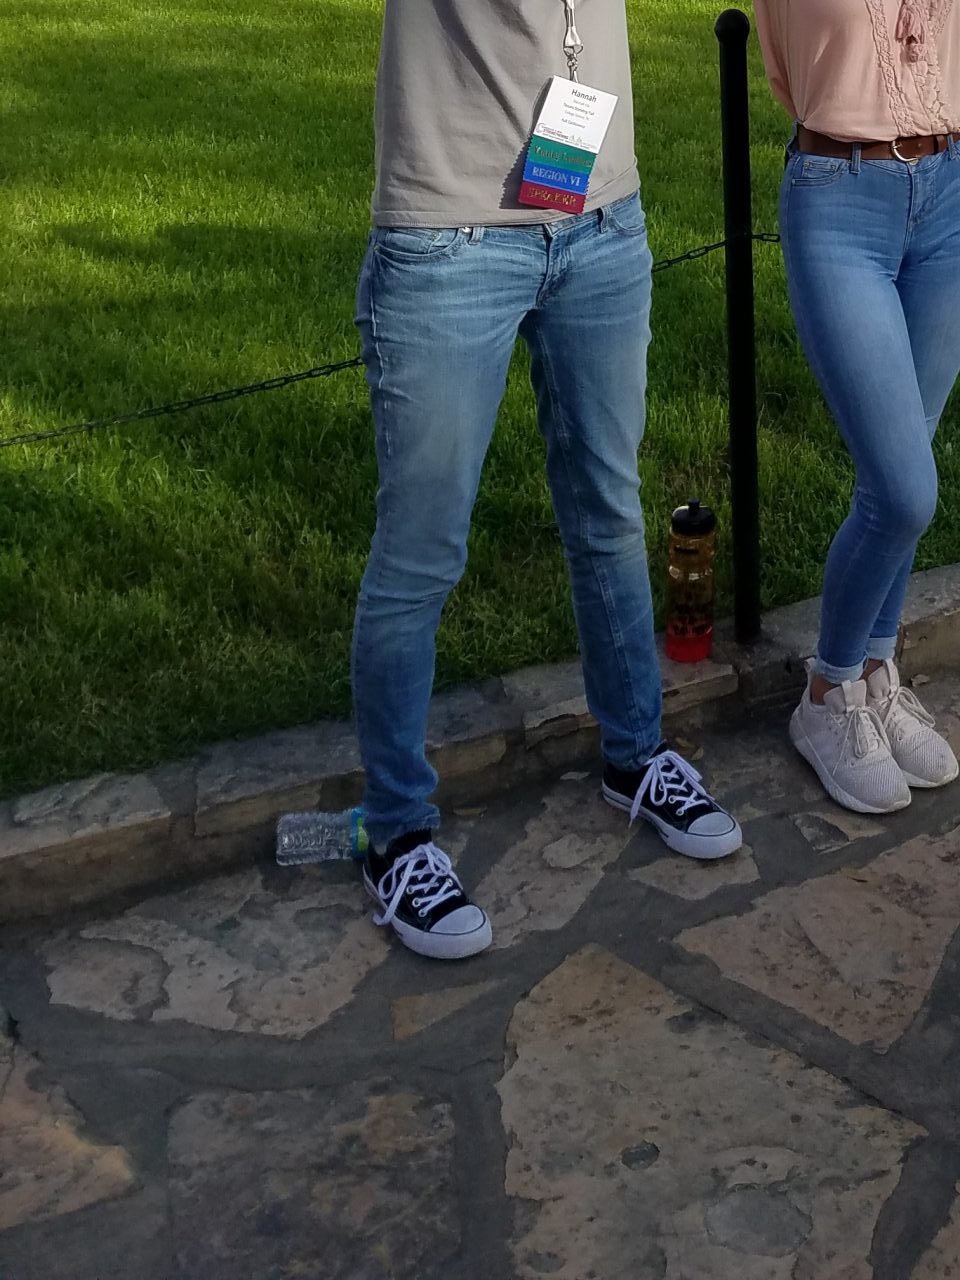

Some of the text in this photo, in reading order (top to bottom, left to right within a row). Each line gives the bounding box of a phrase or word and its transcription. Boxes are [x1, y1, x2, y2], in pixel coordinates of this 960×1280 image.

[571, 89, 597, 103] Hannah
[532, 166, 581, 187] REGION VI
